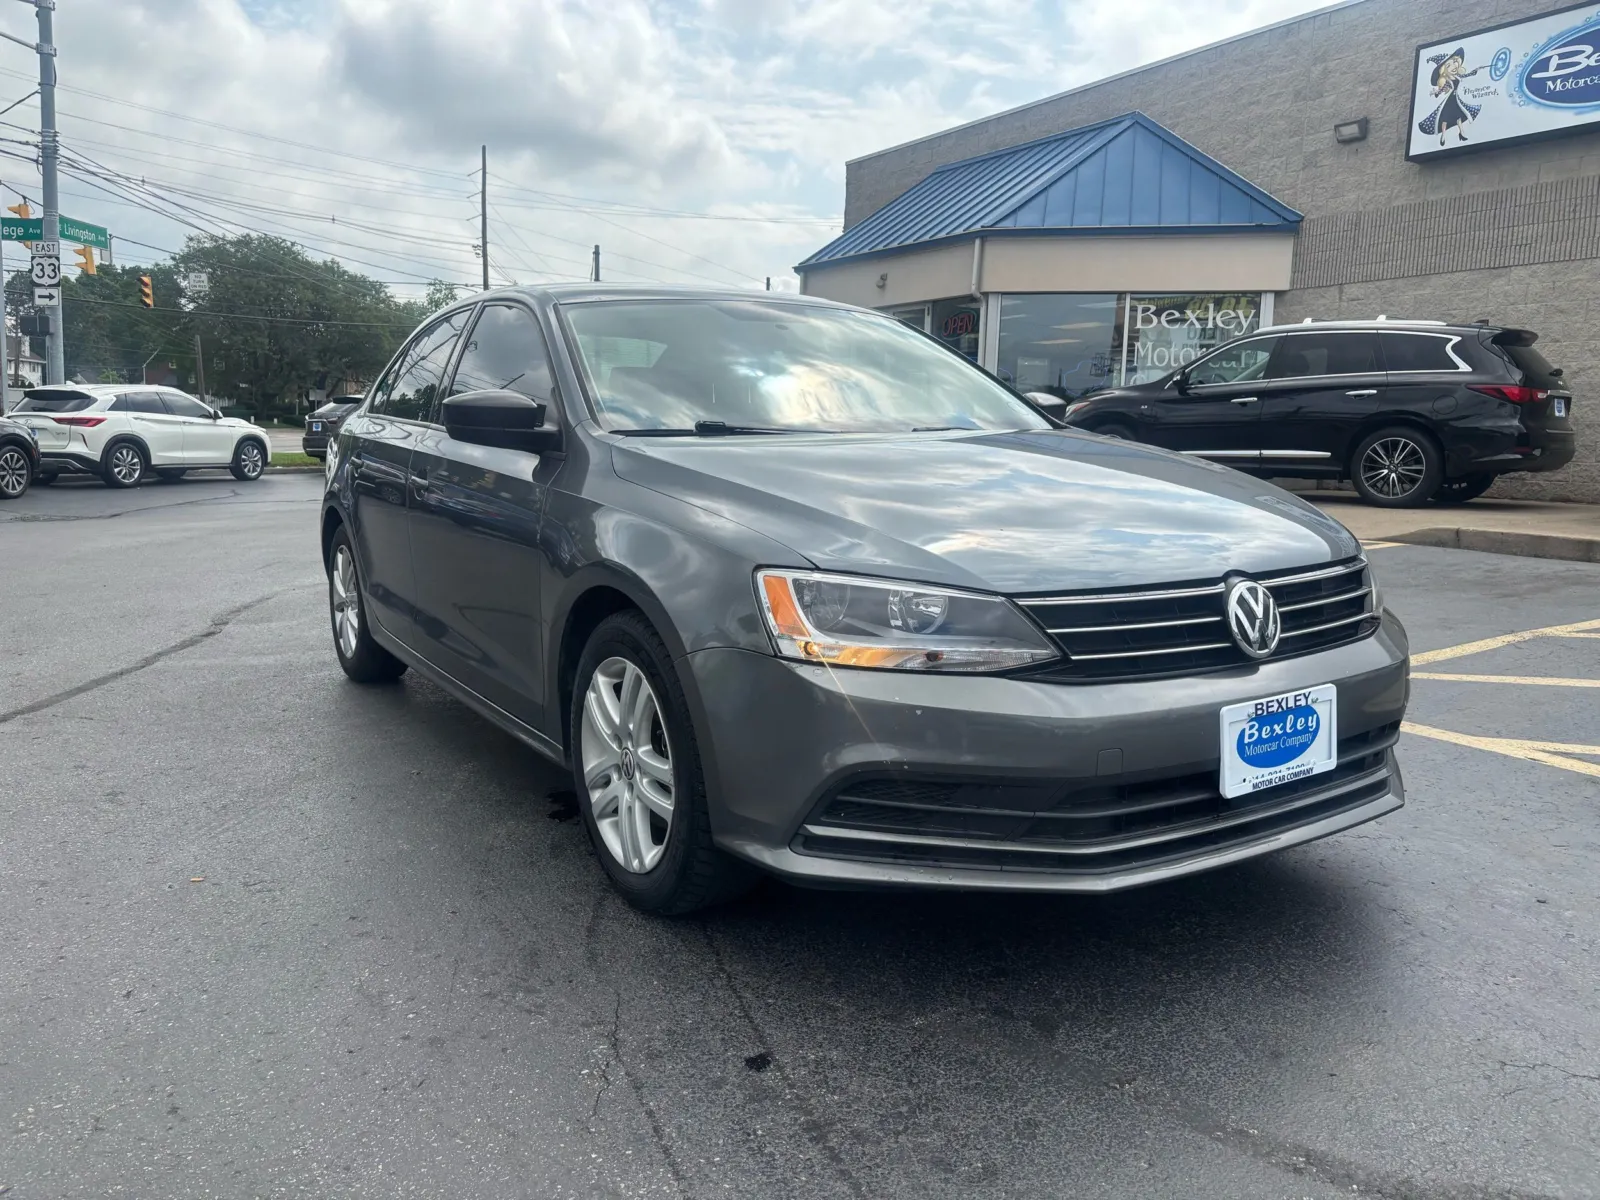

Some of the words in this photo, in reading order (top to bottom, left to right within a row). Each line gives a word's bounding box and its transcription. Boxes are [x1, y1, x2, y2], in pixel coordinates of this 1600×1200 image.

[64, 222, 96, 242] Livingston
[36, 244, 55, 253] EAST
[35, 262, 57, 279] 33
[942, 314, 974, 336] OPEN
[1134, 303, 1256, 336] Bexley
[1255, 691, 1311, 717] BEXLEY
[1244, 714, 1317, 743] Bexley
[1244, 740, 1278, 757] Motorcar
[1280, 732, 1313, 748] Company
[1252, 778, 1273, 790] MOTOR
[1274, 774, 1286, 784] CAR
[1286, 766, 1314, 781] COMPANY
